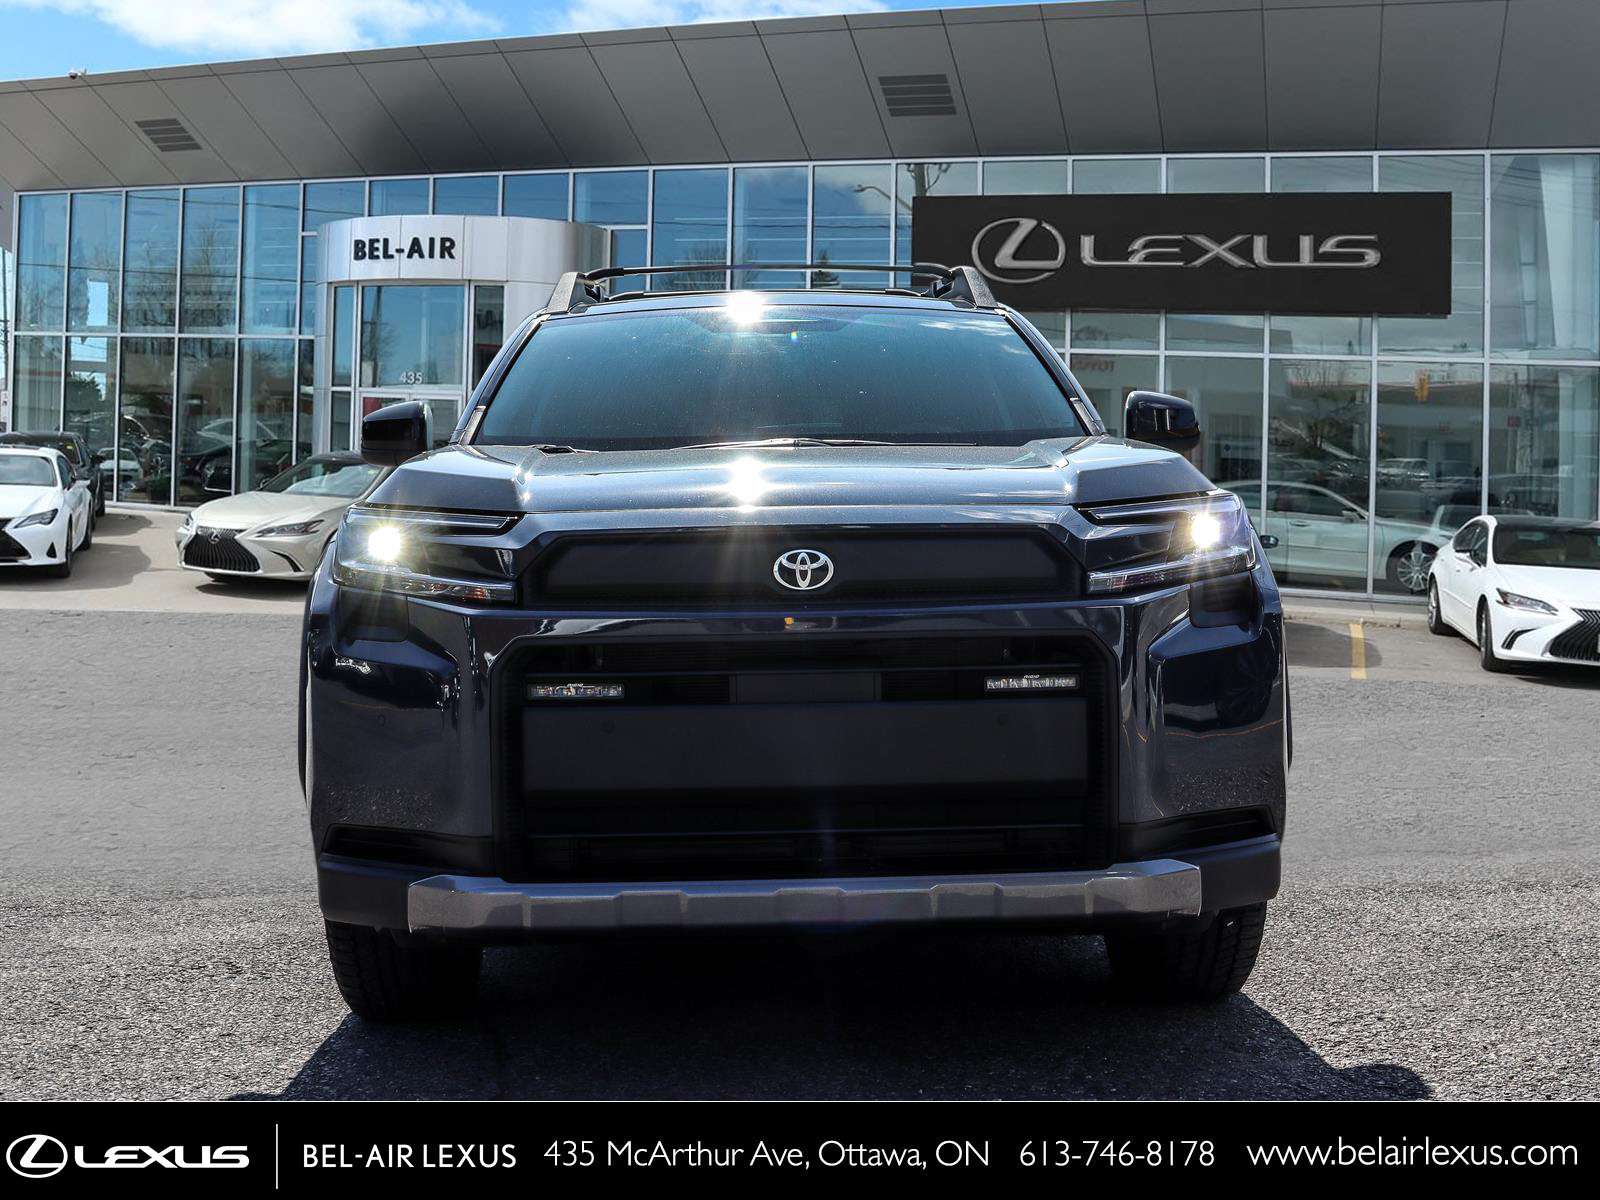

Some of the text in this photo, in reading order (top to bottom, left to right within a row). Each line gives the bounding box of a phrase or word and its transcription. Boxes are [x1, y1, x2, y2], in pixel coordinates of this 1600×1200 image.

[353, 236, 456, 261] BEL-AIR
[1079, 233, 1381, 268] LEXUS
[400, 371, 423, 385] 435
